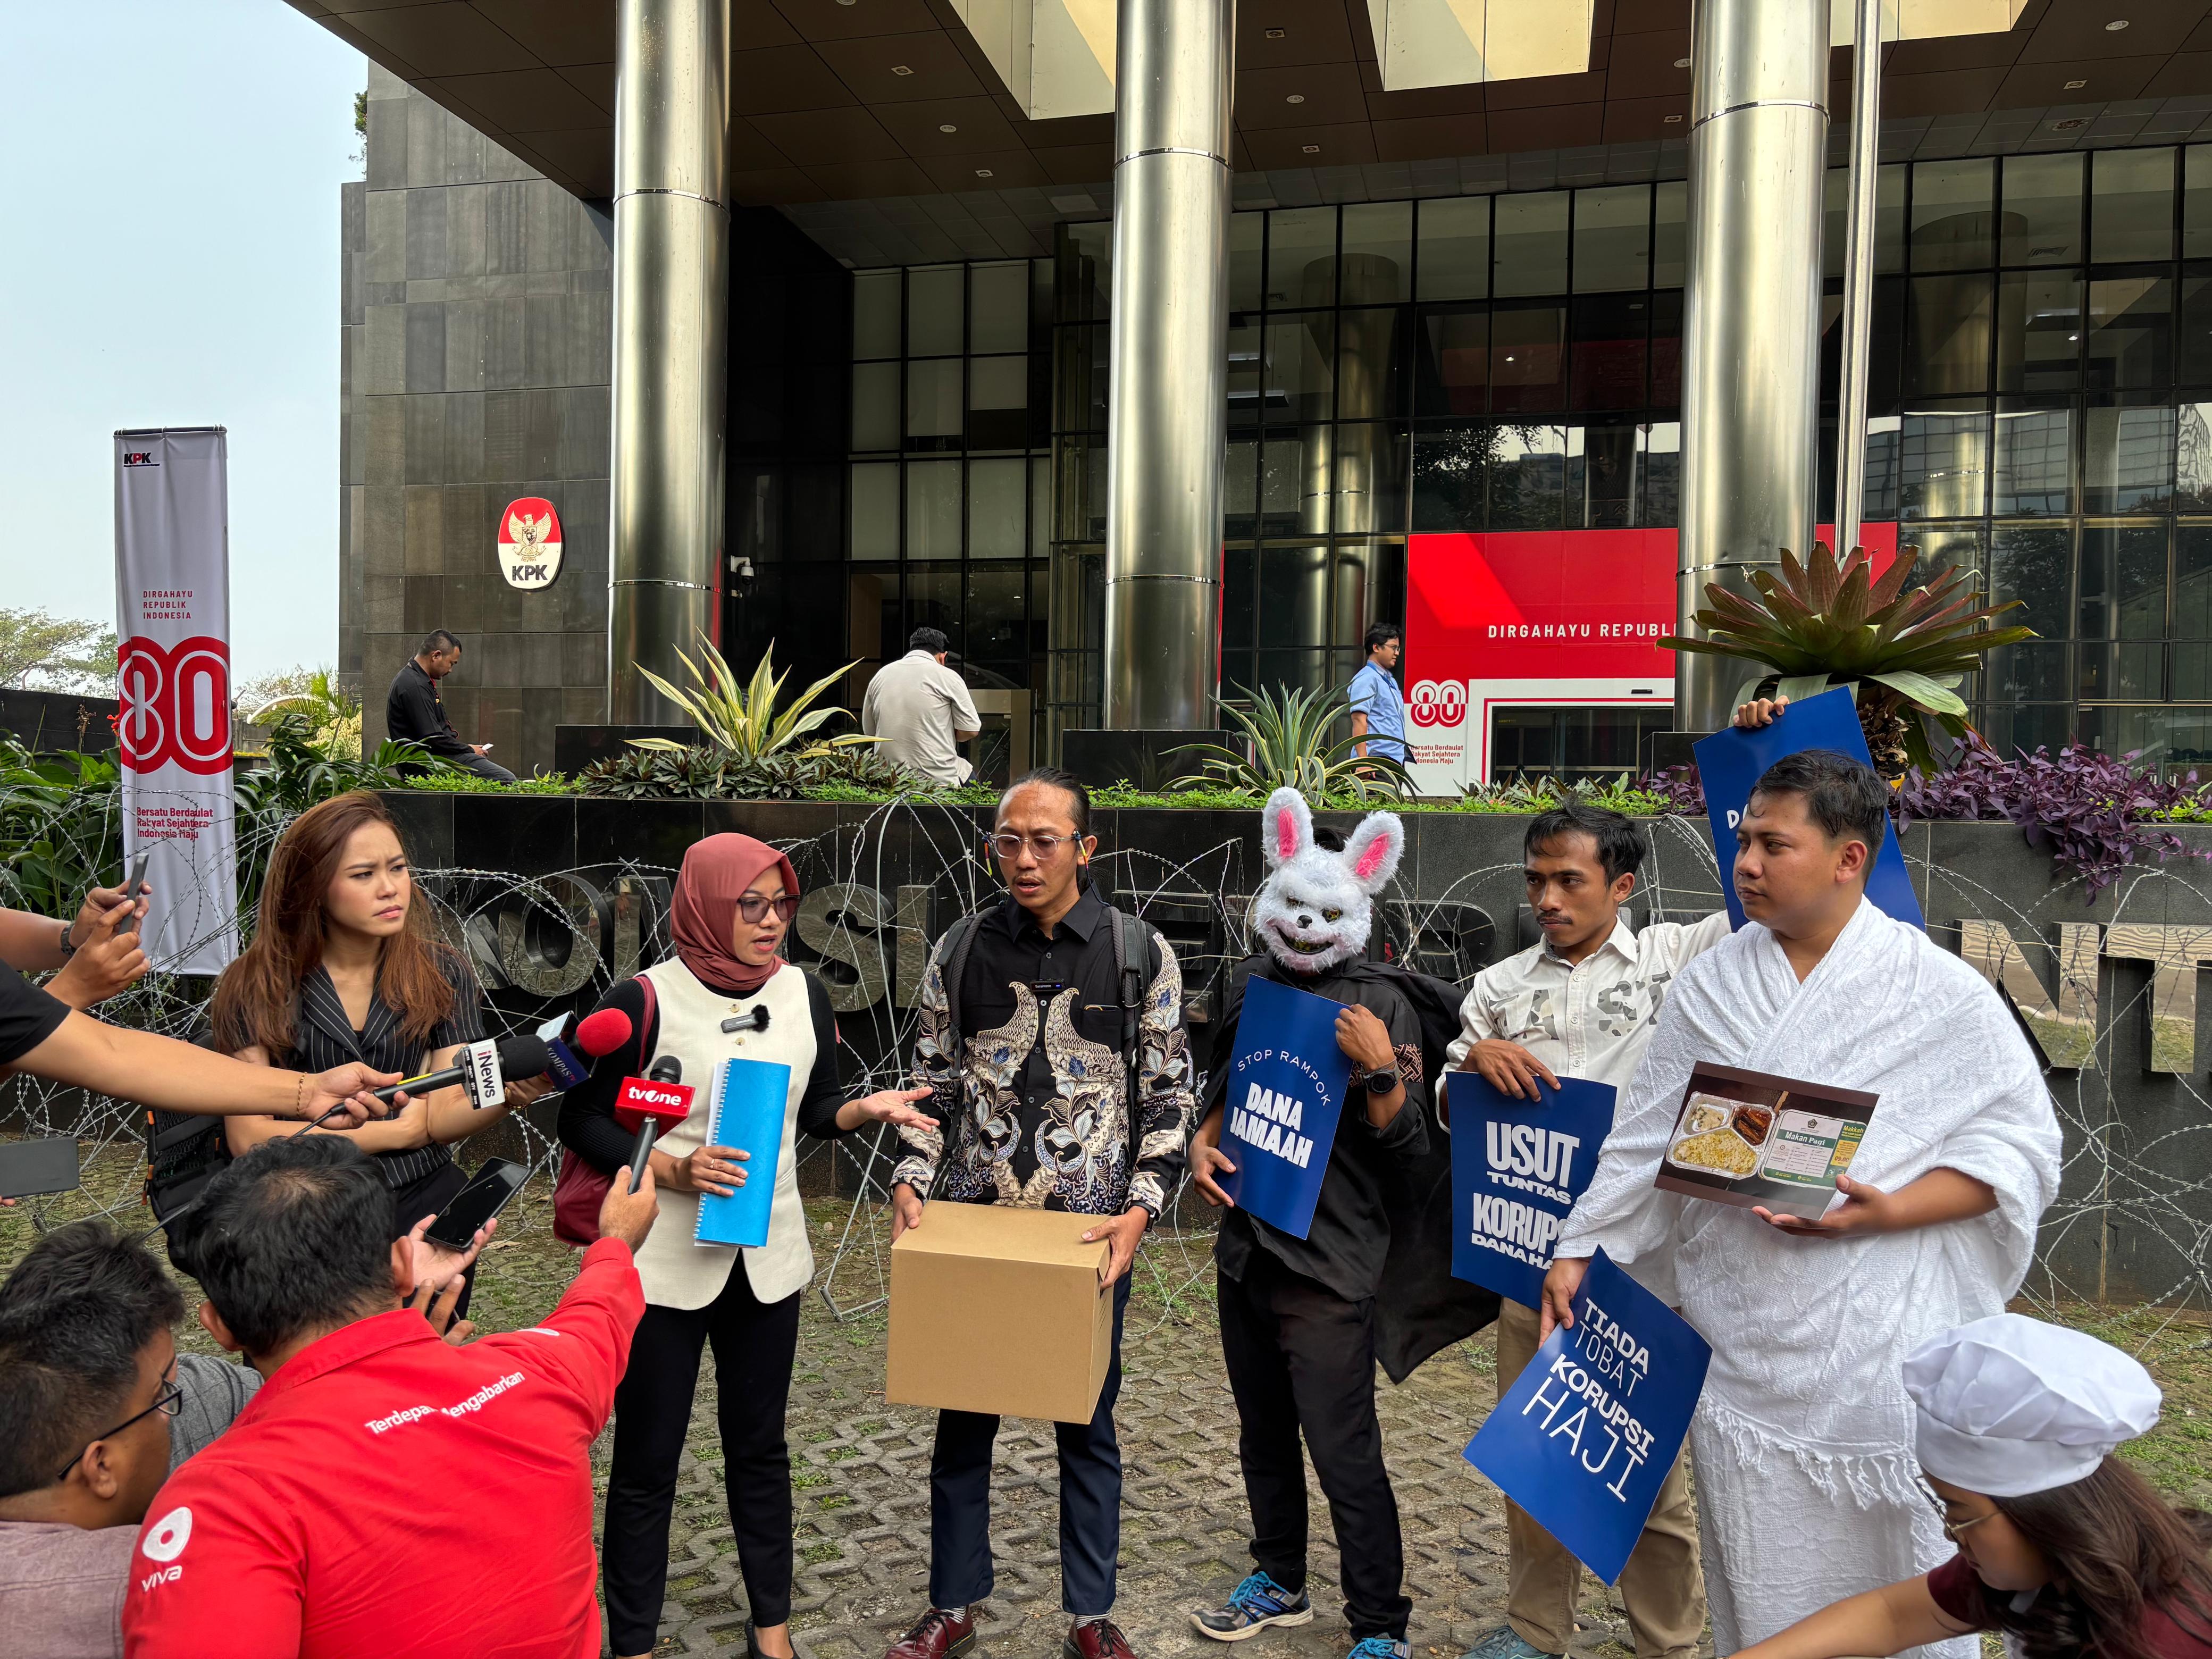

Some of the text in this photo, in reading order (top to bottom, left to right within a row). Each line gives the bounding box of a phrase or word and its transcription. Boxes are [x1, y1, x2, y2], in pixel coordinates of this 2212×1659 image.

[124, 452, 152, 464] KPK
[512, 565, 548, 581] KPK
[1488, 623, 1677, 638] DIRGAHAYU REPUBLI
[118, 636, 233, 775] 80
[1411, 679, 1466, 728] 80
[137, 807, 213, 817] Bersatu Berdaulat
[137, 817, 209, 830] Rakyat Sejahtera
[138, 828, 199, 841] Indonesia Maju
[477, 1050, 496, 1098] iNews
[1238, 1049, 1331, 1107] STOP RAMPOK
[1245, 1082, 1303, 1132] DANA
[1229, 1106, 1314, 1169] JAMAAH
[1486, 1120, 1580, 1188] USUT
[1784, 1131, 1825, 1146] Makan Pagi
[1487, 1171, 1572, 1205] TUNTAS
[1471, 1233, 1528, 1263] DANA
[1574, 1320, 1644, 1397] TOBAT
[1583, 1297, 1649, 1375] TIADA
[1549, 1353, 1655, 1458] KORUPSI
[1522, 1376, 1644, 1503] HAJI
[141, 1565, 183, 1593] viva
